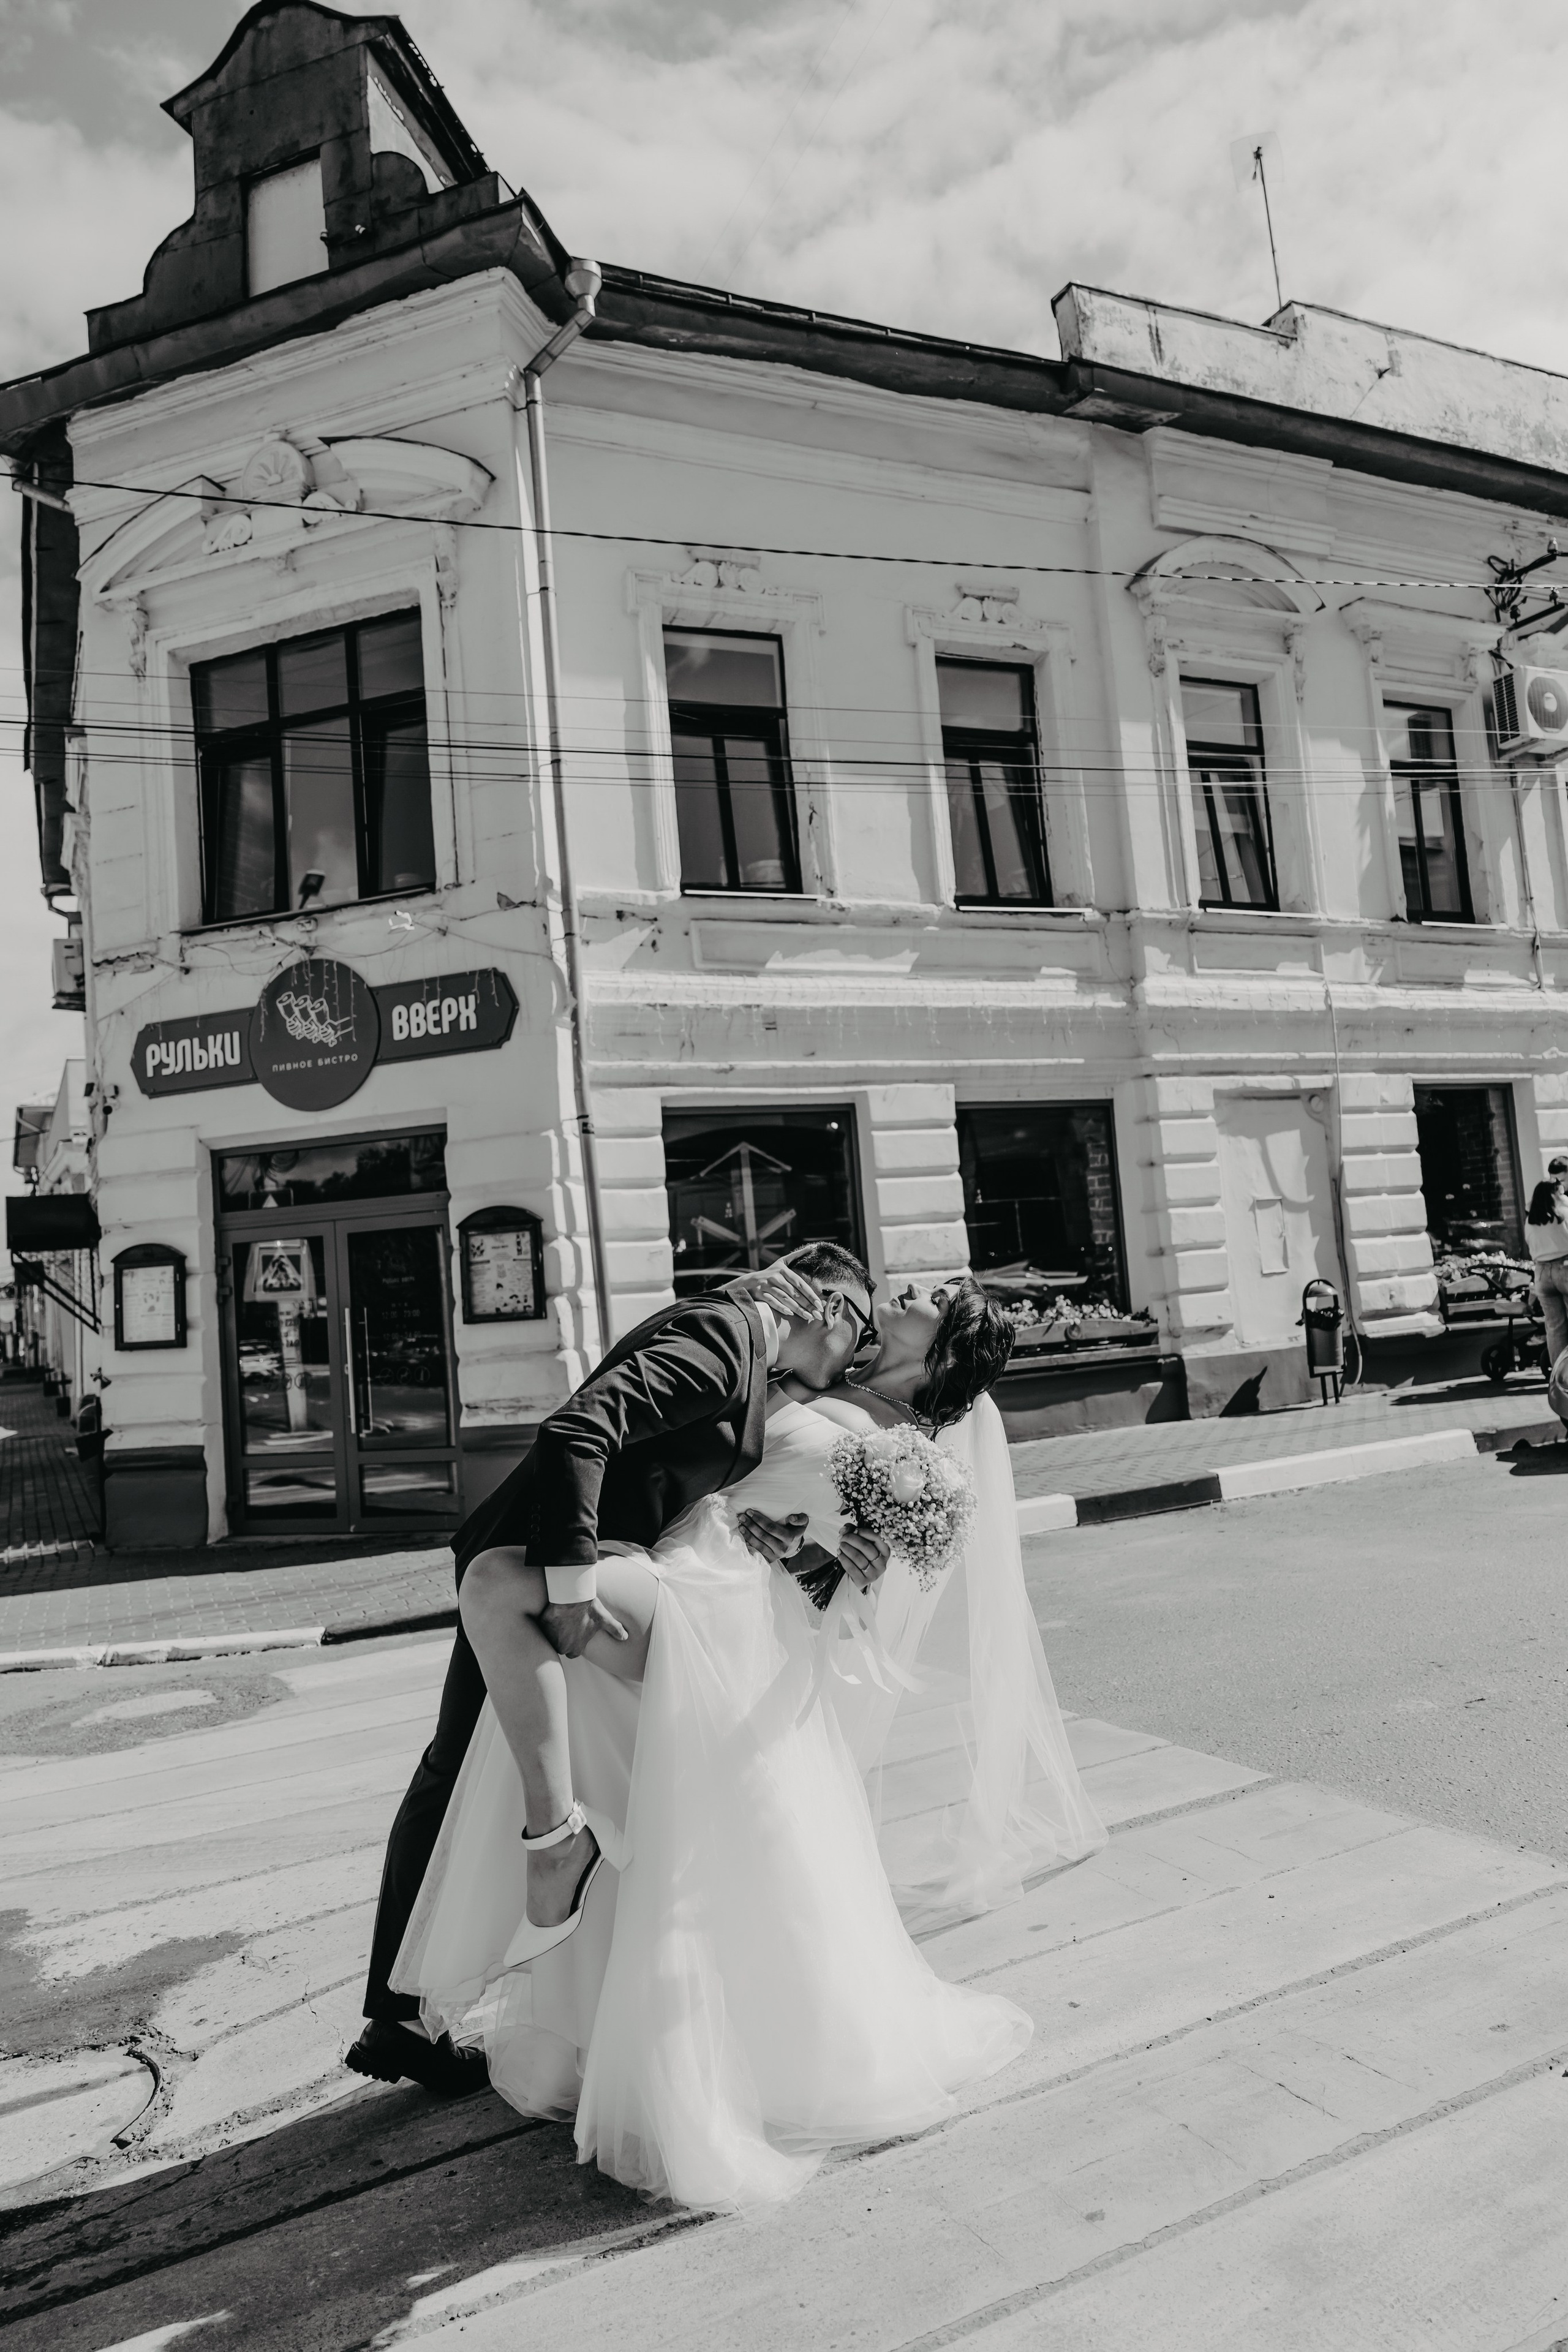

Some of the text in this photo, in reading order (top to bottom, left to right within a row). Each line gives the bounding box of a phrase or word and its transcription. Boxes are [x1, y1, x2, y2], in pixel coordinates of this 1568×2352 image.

[146, 994, 477, 1077] РУЛЬКИ ВВЕРХ
[272, 1053, 358, 1072] ПИВНОЕ БИСТРО
